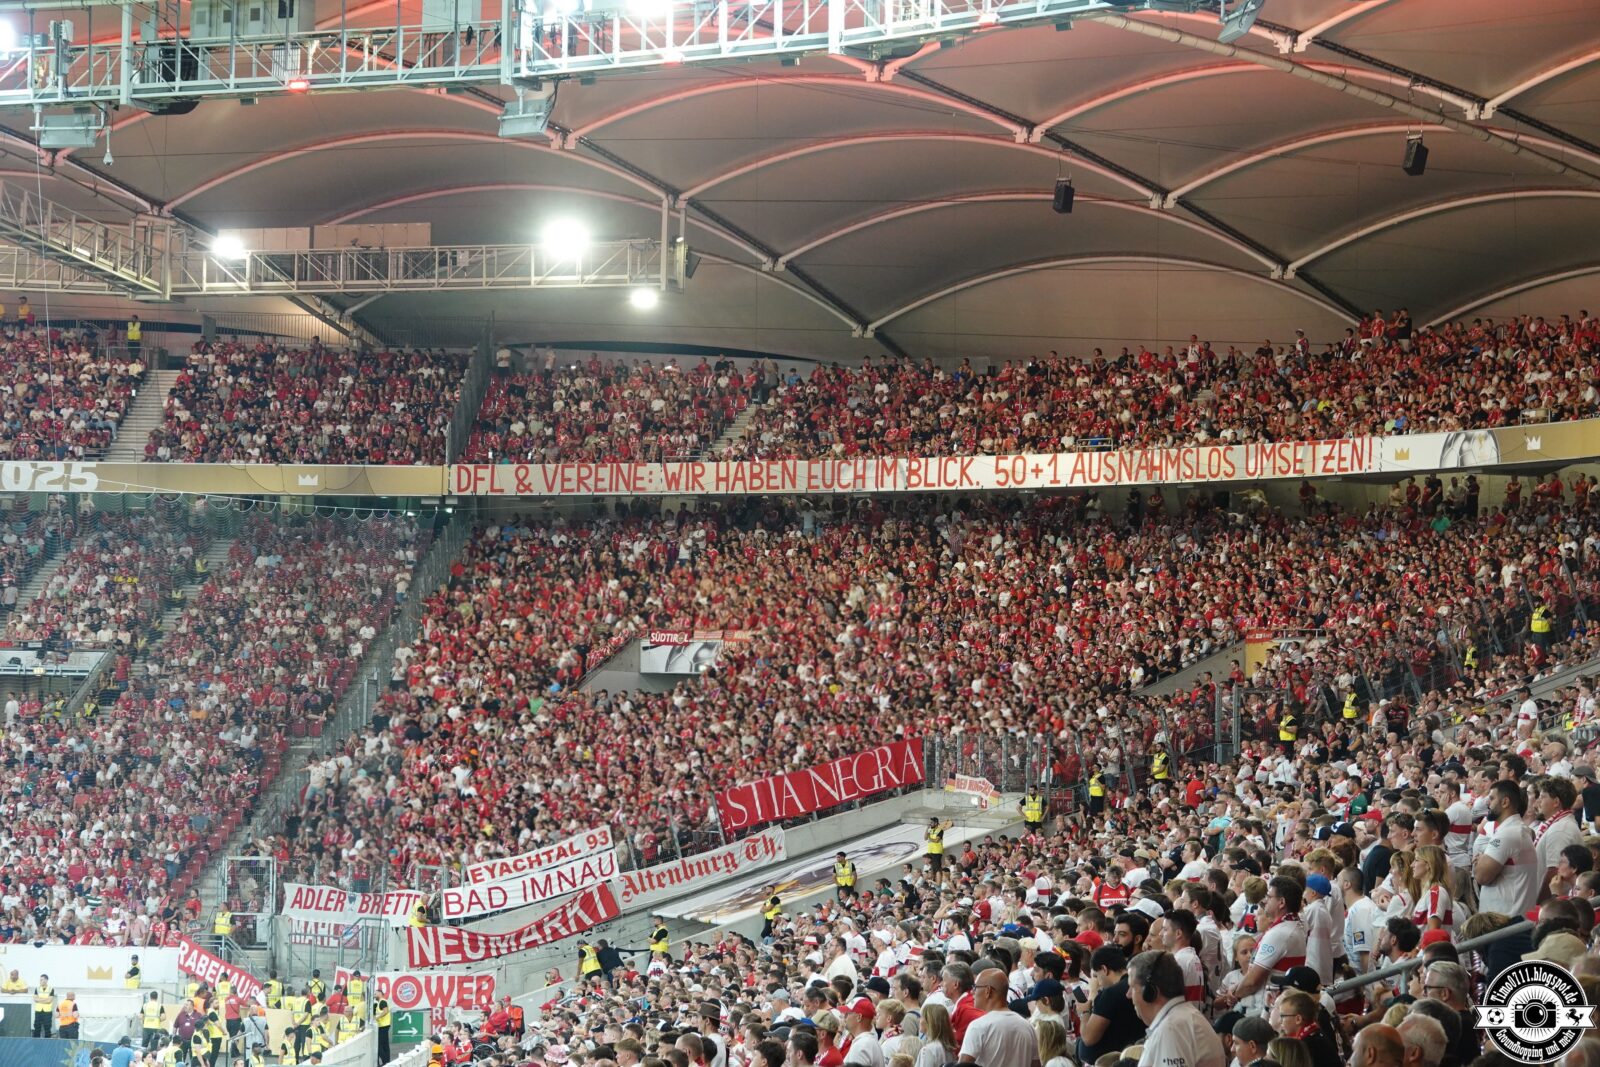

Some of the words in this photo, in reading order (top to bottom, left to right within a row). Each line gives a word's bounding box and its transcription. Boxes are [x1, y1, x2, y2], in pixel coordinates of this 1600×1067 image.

[456, 464, 505, 493] DFL
[514, 464, 534, 494] &
[541, 463, 653, 493] VEREINE:
[662, 462, 706, 492] WIR
[715, 460, 797, 491] HABEN
[807, 459, 866, 489] EUCH
[875, 457, 897, 488] IM
[907, 456, 980, 488] BLICK.
[994, 454, 1061, 486] 50+1
[1070, 447, 1236, 484] AUSNAHMSLOS
[1244, 437, 1374, 476] UMSETZEN!
[806, 741, 923, 808] NEGRA
[443, 886, 508, 916] BAD
[522, 852, 614, 902] IMNAU
[470, 842, 581, 884] EYACHTAL
[586, 830, 609, 849] 93
[290, 887, 347, 913] ADLER
[410, 883, 608, 967] NEUMARKT
[377, 974, 496, 1010] POWER
